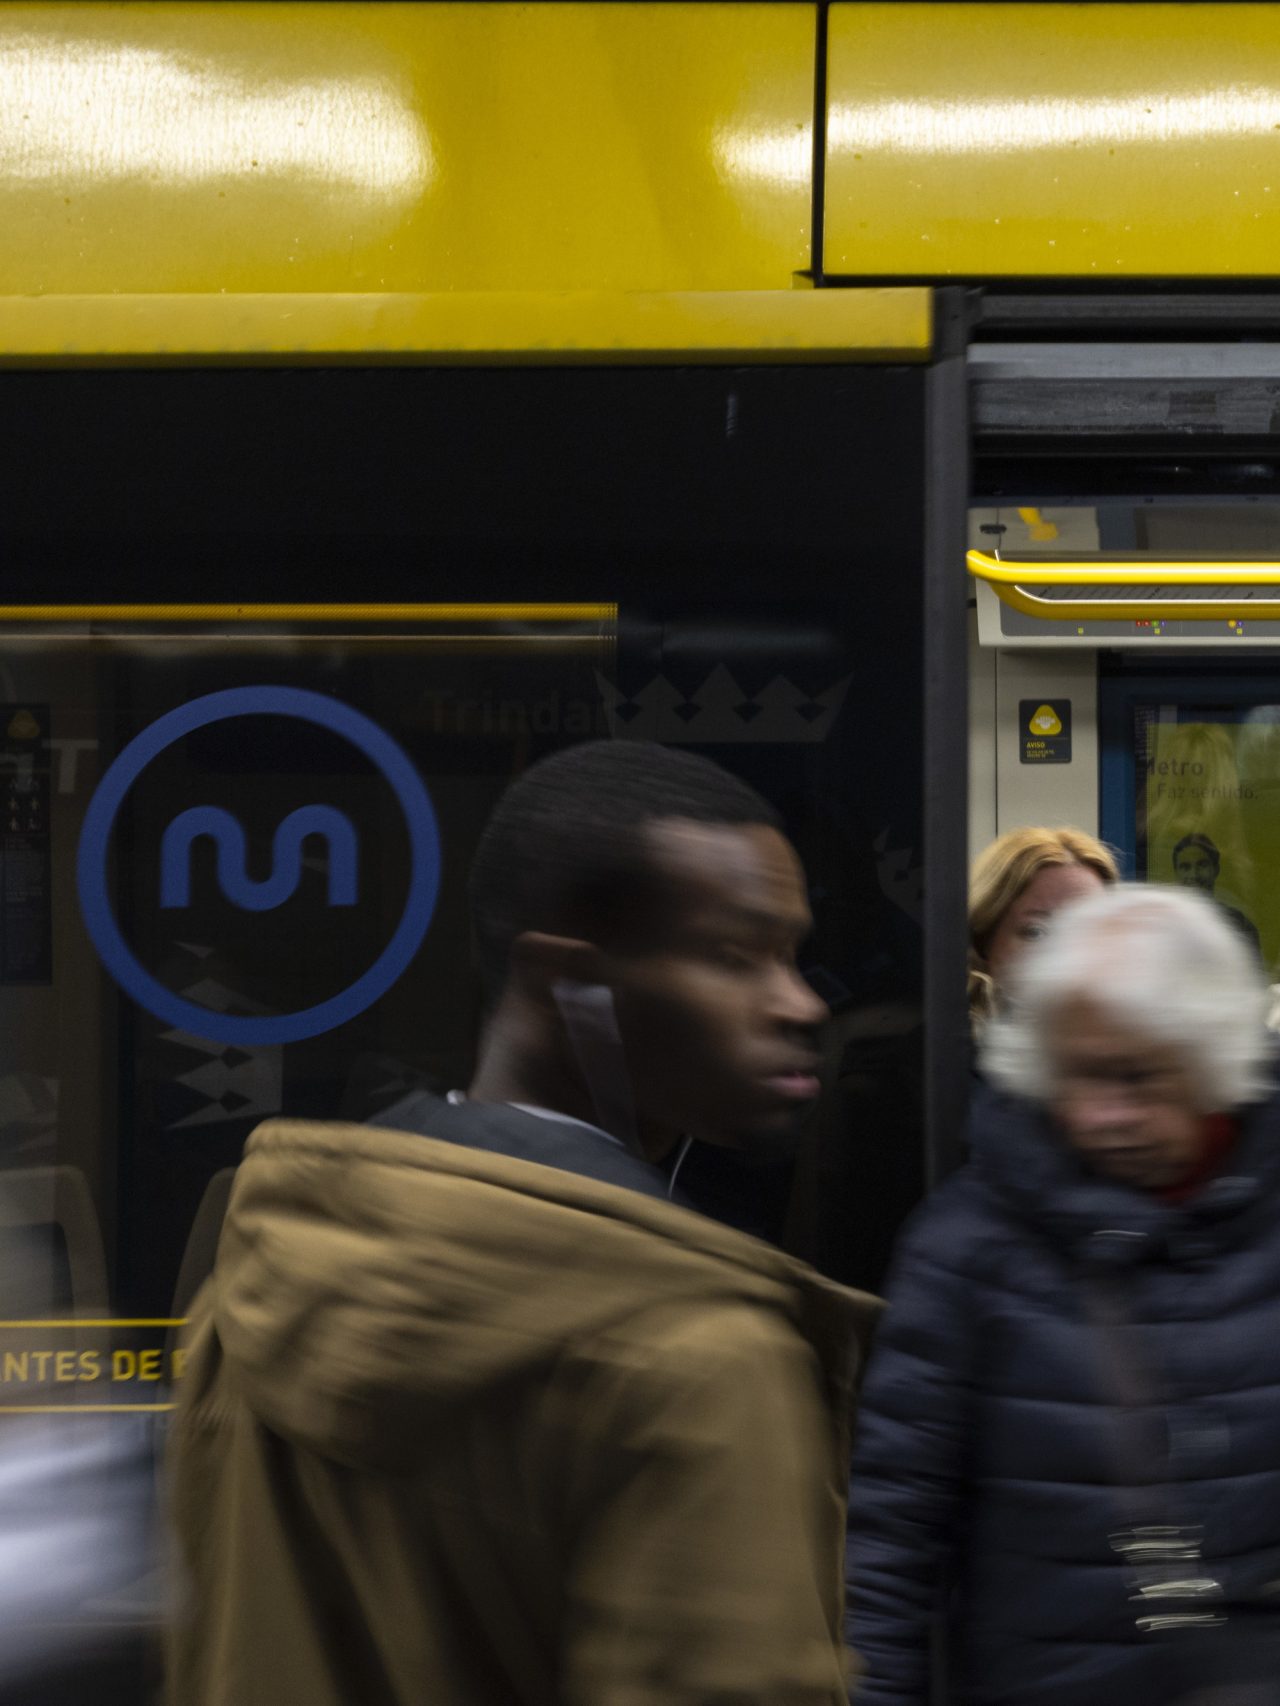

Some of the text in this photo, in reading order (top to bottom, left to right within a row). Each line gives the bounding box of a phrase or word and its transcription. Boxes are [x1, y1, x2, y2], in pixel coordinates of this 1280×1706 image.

[1026, 741, 1046, 749] AVISO
[0, 1350, 101, 1382] NTES
[112, 1349, 161, 1381] DE
